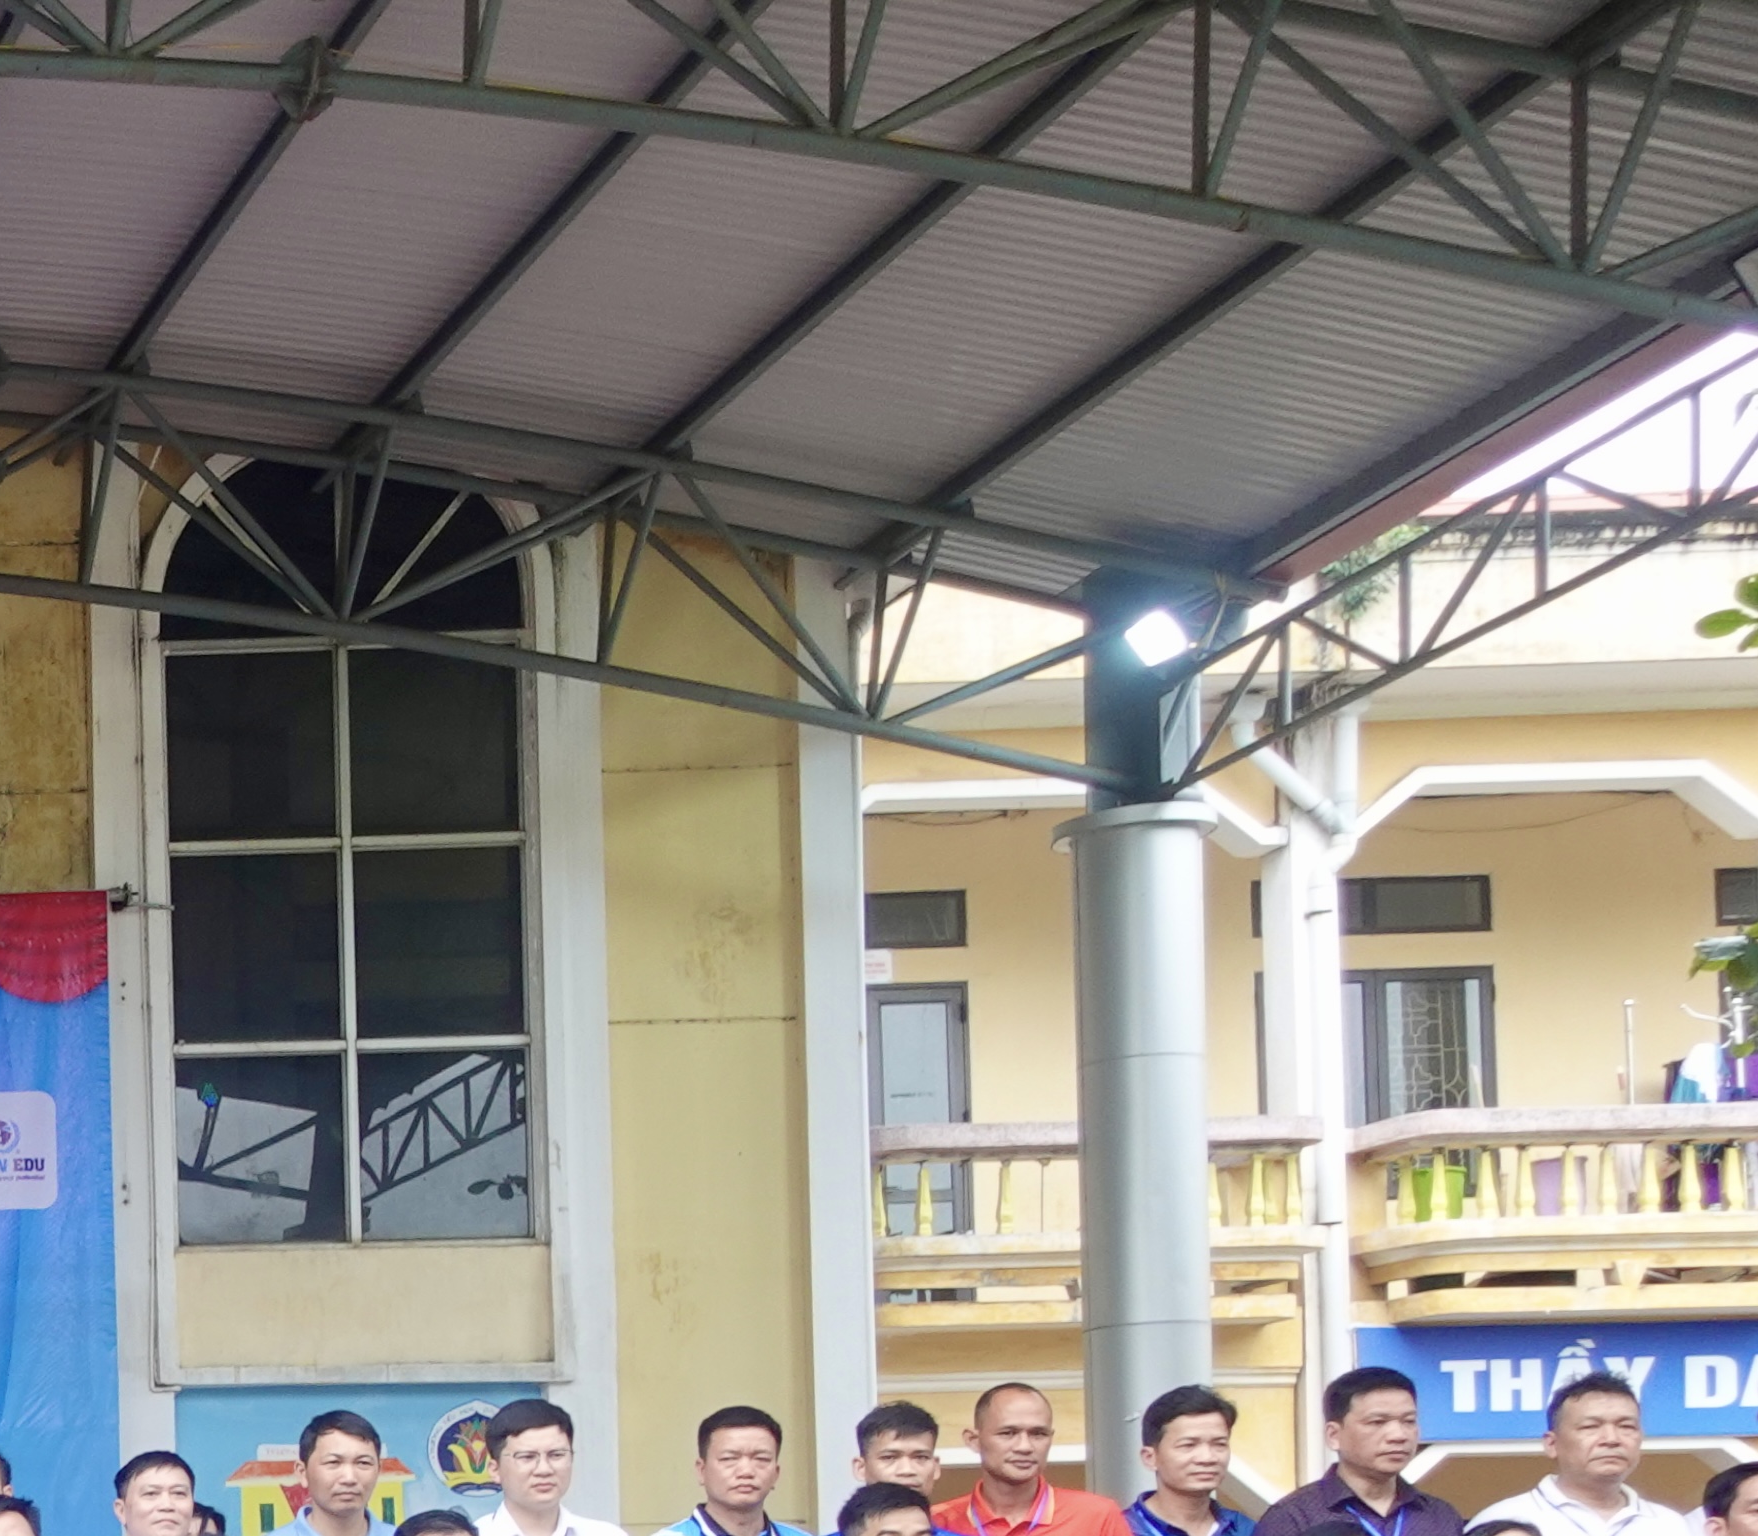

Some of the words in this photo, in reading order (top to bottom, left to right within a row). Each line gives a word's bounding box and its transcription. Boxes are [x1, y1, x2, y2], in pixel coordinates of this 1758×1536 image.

[13, 1158, 45, 1171] EDU
[1440, 1338, 1656, 1413] THẦY
[1684, 1354, 1758, 1409] D
